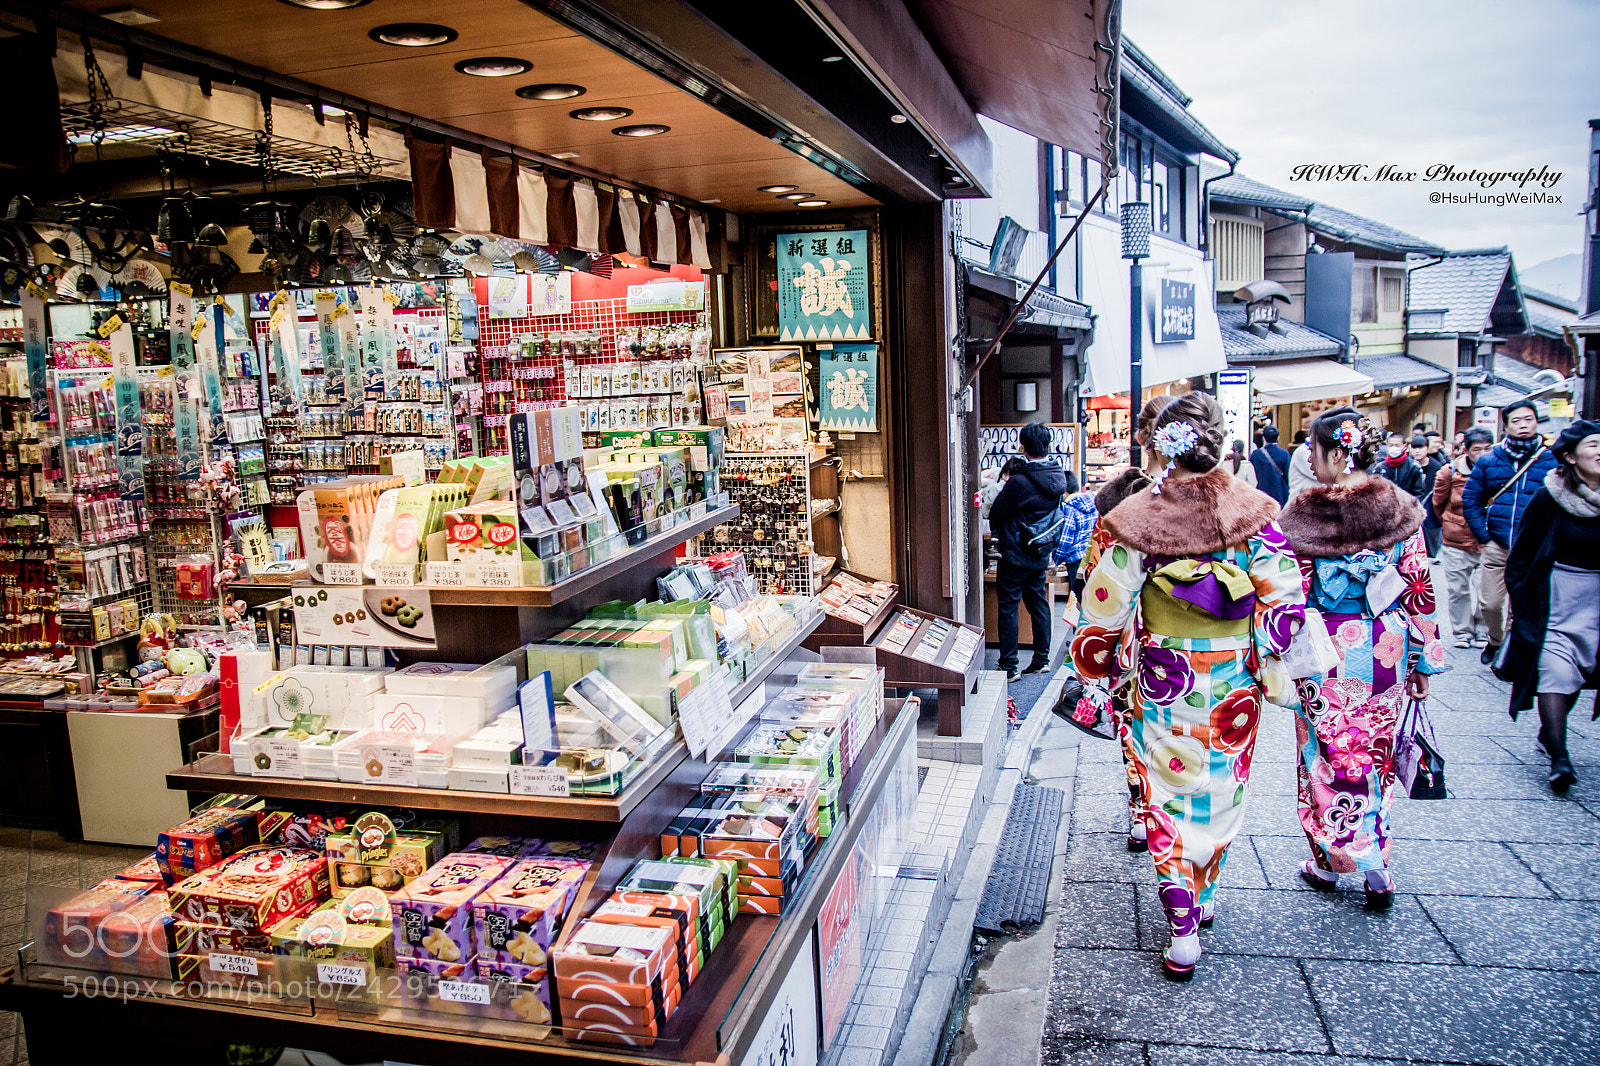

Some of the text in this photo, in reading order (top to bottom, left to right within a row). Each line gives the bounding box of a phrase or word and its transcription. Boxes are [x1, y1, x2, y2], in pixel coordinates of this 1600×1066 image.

[787, 237, 856, 258] 新選組
[793, 257, 855, 319] 誠
[829, 351, 869, 363] 新選組
[826, 368, 870, 413] 誠
[612, 436, 640, 449] Caplico
[361, 846, 389, 865] Pringles
[306, 945, 334, 959] Pringles
